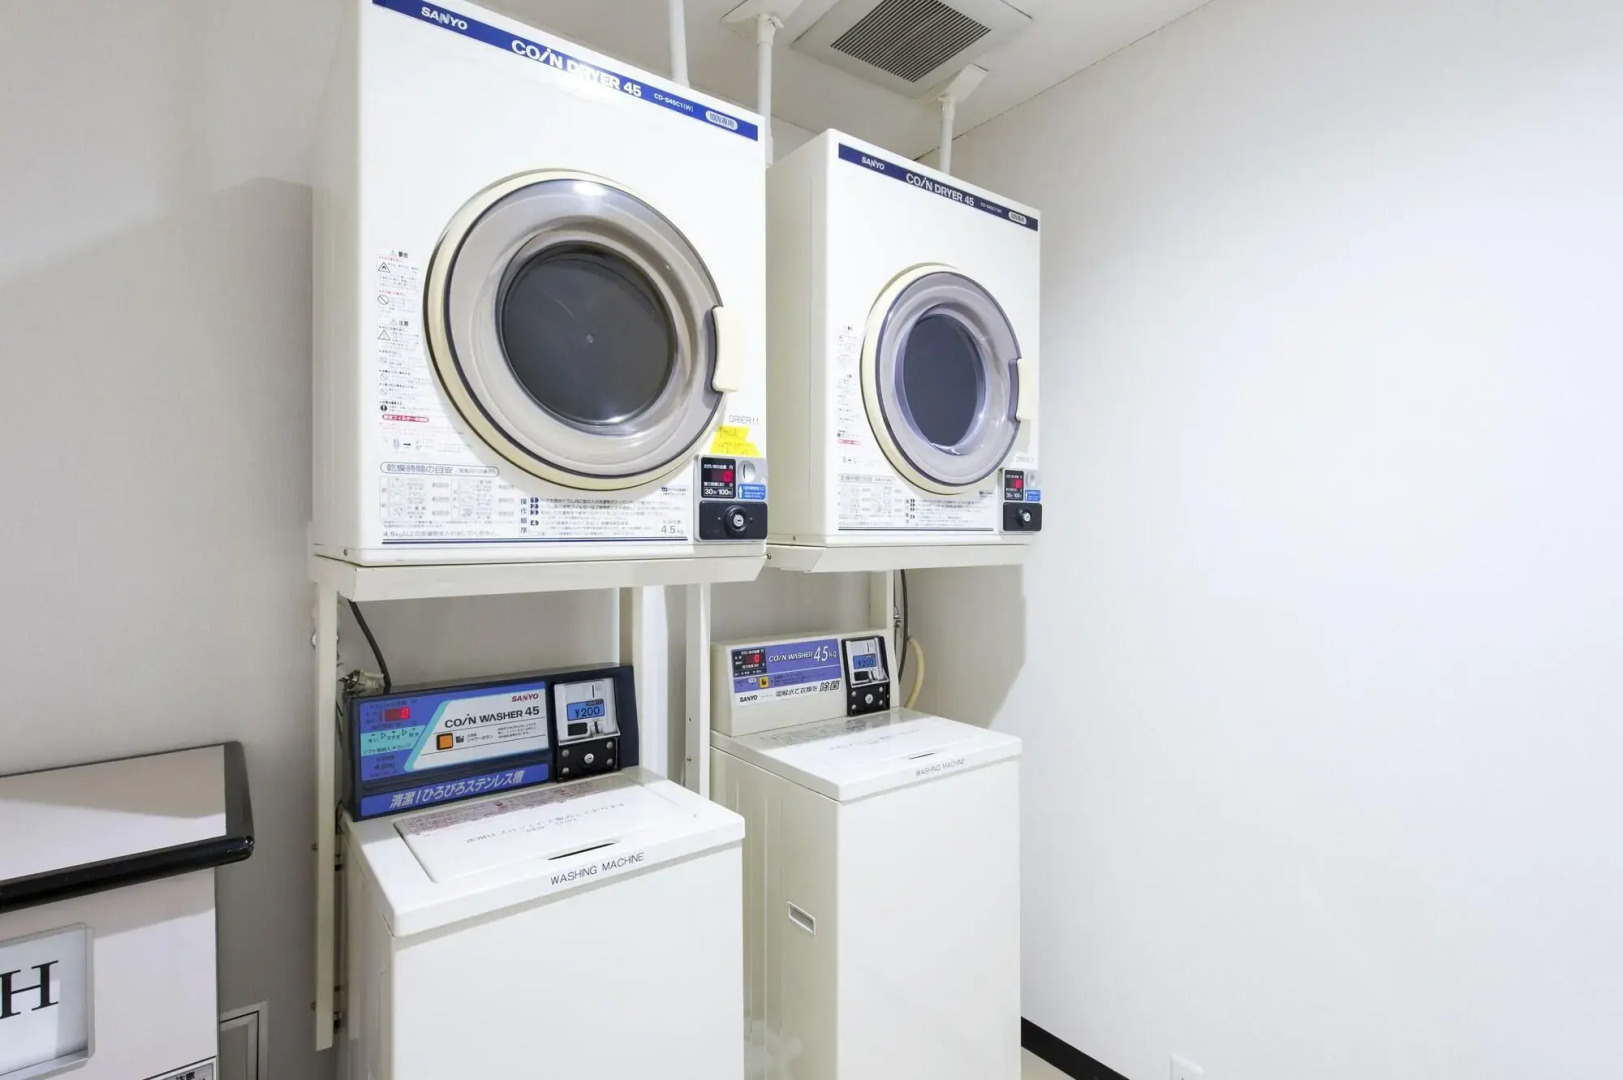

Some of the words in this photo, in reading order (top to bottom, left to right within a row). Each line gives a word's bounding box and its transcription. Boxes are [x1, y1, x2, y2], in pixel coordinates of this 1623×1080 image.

[421, 6, 468, 30] SANYO
[511, 39, 563, 69] COIN
[566, 58, 620, 92] DRYER
[623, 80, 642, 97] 45
[861, 156, 885, 171] SANYO
[906, 173, 933, 191] COIN
[934, 183, 963, 203] DRYER
[964, 195, 975, 206] 45
[768, 654, 787, 663] COIN
[788, 651, 813, 660] WASHER
[511, 693, 539, 702] SANYO
[739, 694, 758, 703] SANYO
[444, 713, 477, 728] COIN
[479, 709, 523, 723] WASHER
[524, 705, 540, 716] 45
[916, 764, 941, 778] WASHING
[550, 865, 598, 886] WASHING
[601, 852, 645, 872] MACHINE
